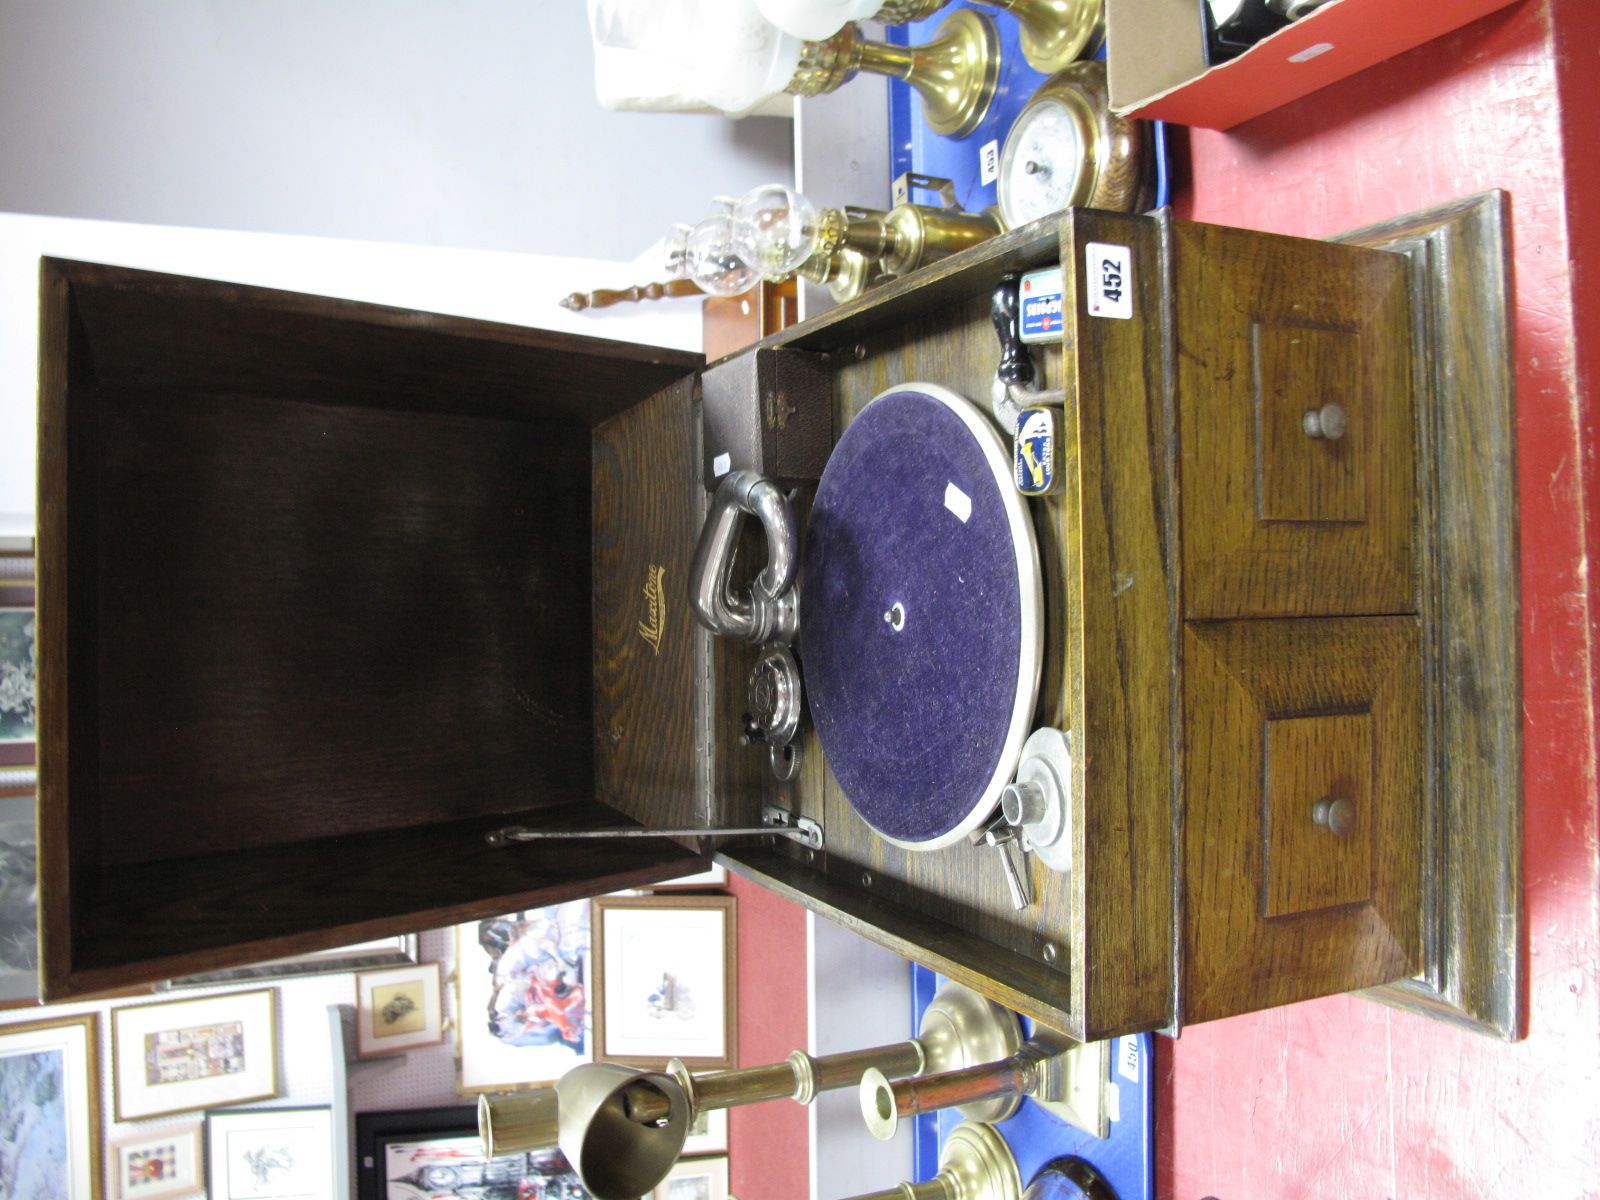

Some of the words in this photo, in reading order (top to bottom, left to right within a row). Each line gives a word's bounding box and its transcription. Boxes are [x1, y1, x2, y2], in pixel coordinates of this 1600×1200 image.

[987, 149, 995, 173] 453
[1102, 259, 1122, 303] 452
[1127, 1042, 1138, 1071] 450
